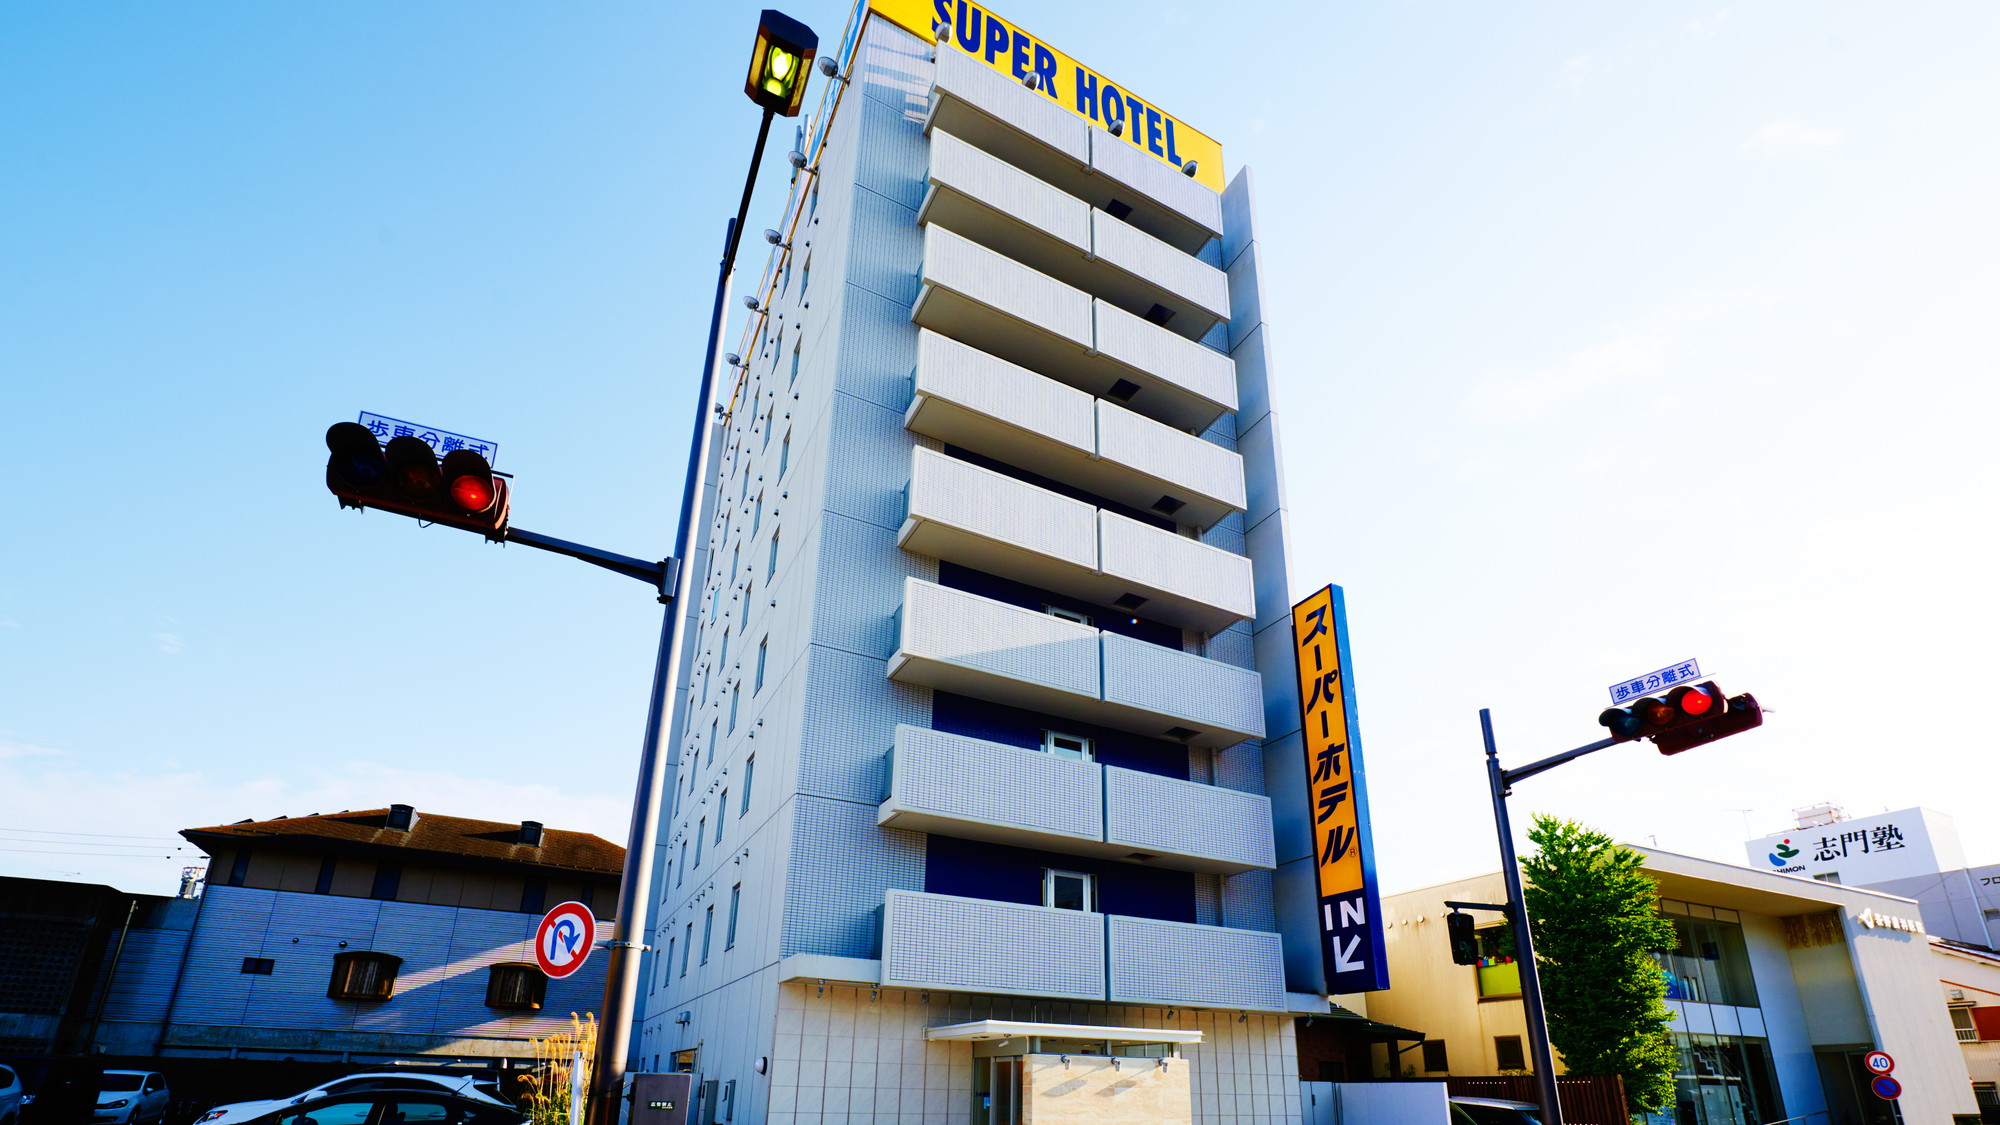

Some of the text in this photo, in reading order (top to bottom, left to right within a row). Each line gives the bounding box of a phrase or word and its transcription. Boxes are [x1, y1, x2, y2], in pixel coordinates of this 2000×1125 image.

[931, 0, 1182, 168] SUPER HOTEL
[1616, 664, 1695, 700] 歩車分離式
[1302, 604, 1355, 868] スーパーホテル
[1813, 824, 1905, 862] 志門塾
[1773, 865, 1806, 873] HIMON
[1324, 897, 1366, 931] IN
[1872, 1057, 1889, 1069] 40
